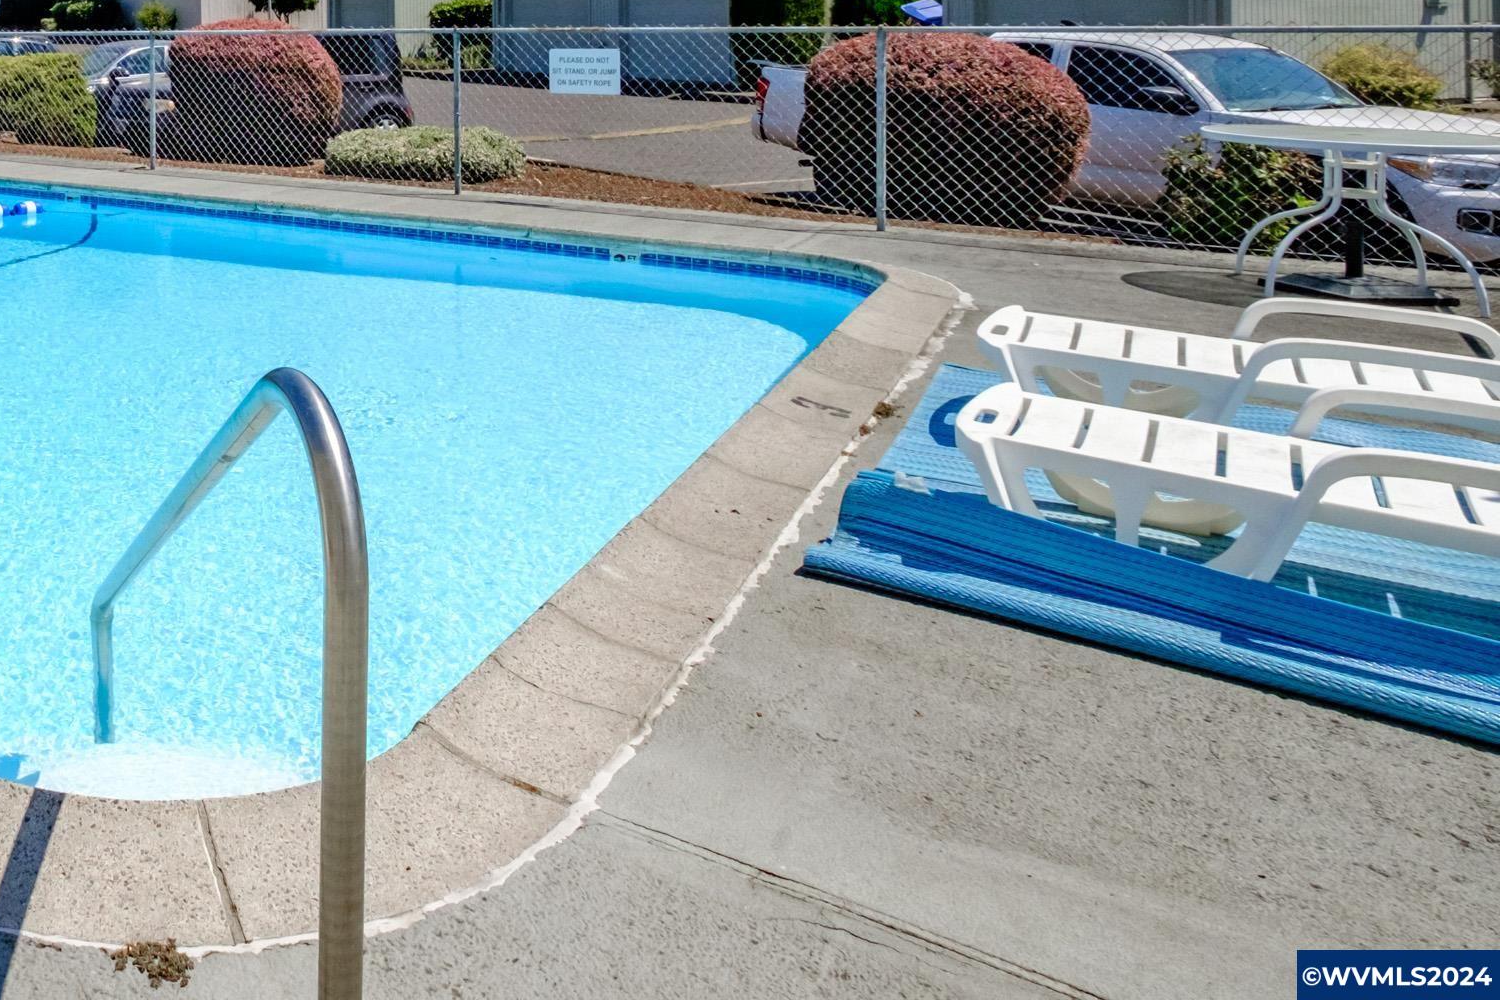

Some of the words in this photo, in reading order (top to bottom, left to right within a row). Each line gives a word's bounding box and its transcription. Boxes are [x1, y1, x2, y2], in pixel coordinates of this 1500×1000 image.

[559, 56, 583, 64] PLEASE
[585, 56, 595, 64] DO
[596, 56, 610, 65] NOT
[593, 79, 612, 87] ROPE
